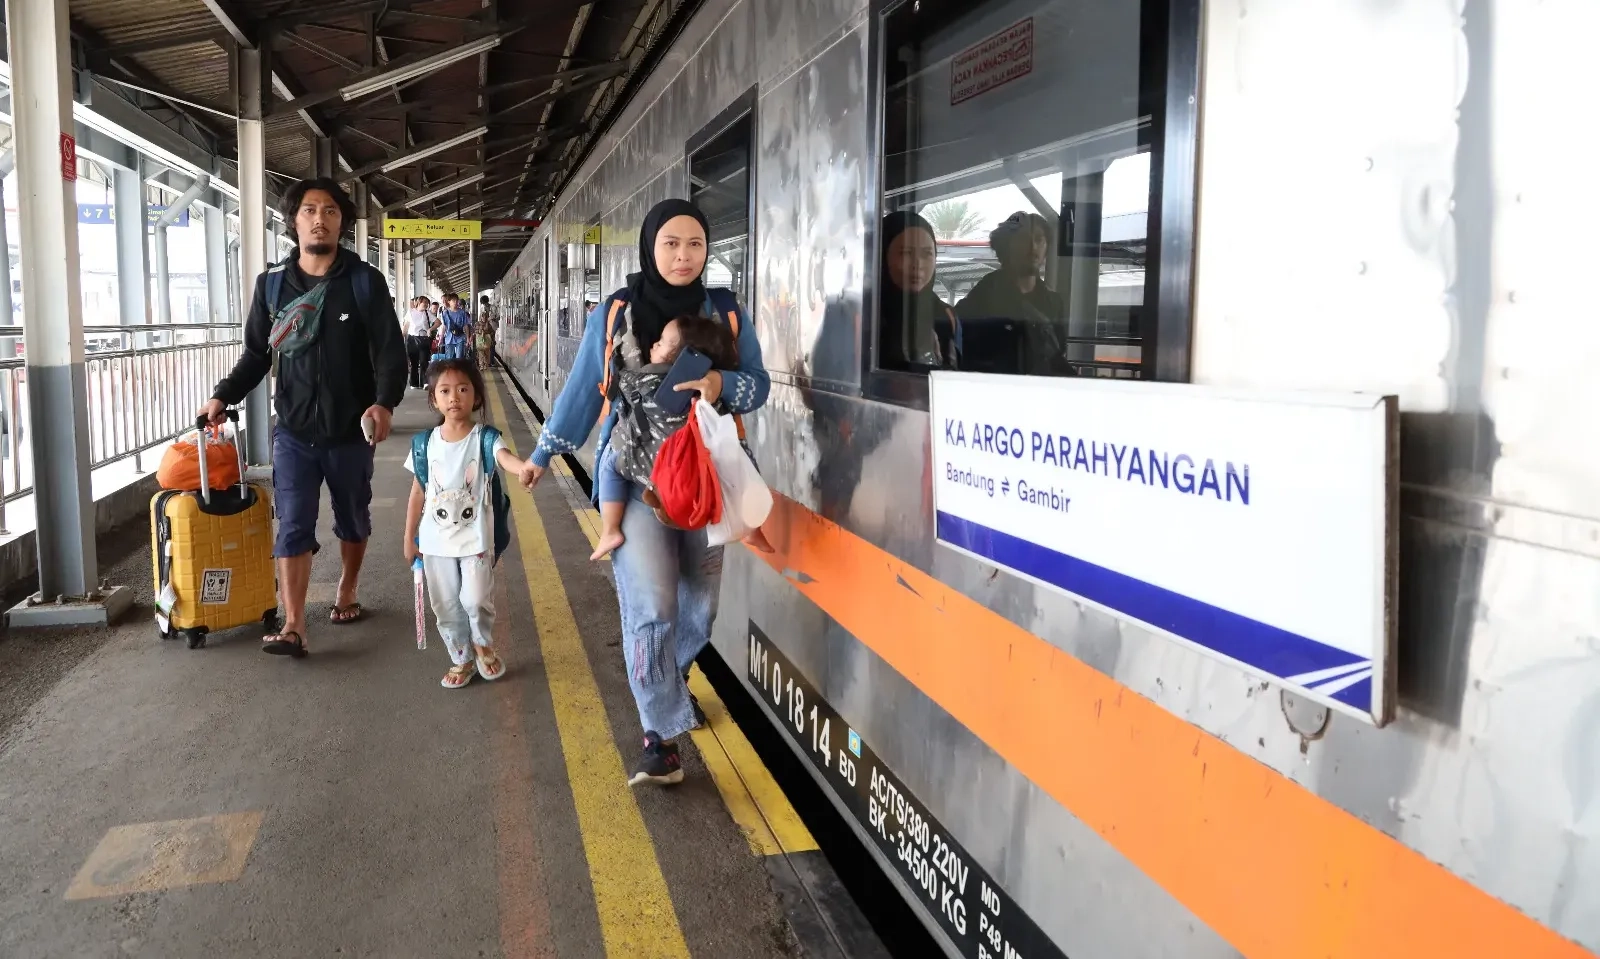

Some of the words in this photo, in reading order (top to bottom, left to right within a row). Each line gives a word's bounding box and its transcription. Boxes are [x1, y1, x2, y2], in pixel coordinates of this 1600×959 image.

[95, 208, 104, 218] 7
[945, 418, 967, 448] KA
[971, 422, 1025, 460] ARGO
[1031, 431, 1251, 506] PARAHYANGAN
[946, 462, 995, 497] Bandung
[1017, 480, 1071, 514] Gambir
[750, 634, 768, 690] M1
[786, 678, 804, 734] 18
[810, 705, 832, 768] 14
[839, 749, 856, 788] BD
[870, 766, 930, 854] AC/TS/380
[932, 836, 969, 896] 220V
[868, 801, 888, 841] BK
[896, 831, 938, 900] 34500
[942, 880, 967, 936] KG
[981, 880, 1000, 916] MD
[980, 912, 1002, 953] P48
[1004, 940, 1023, 959] M
